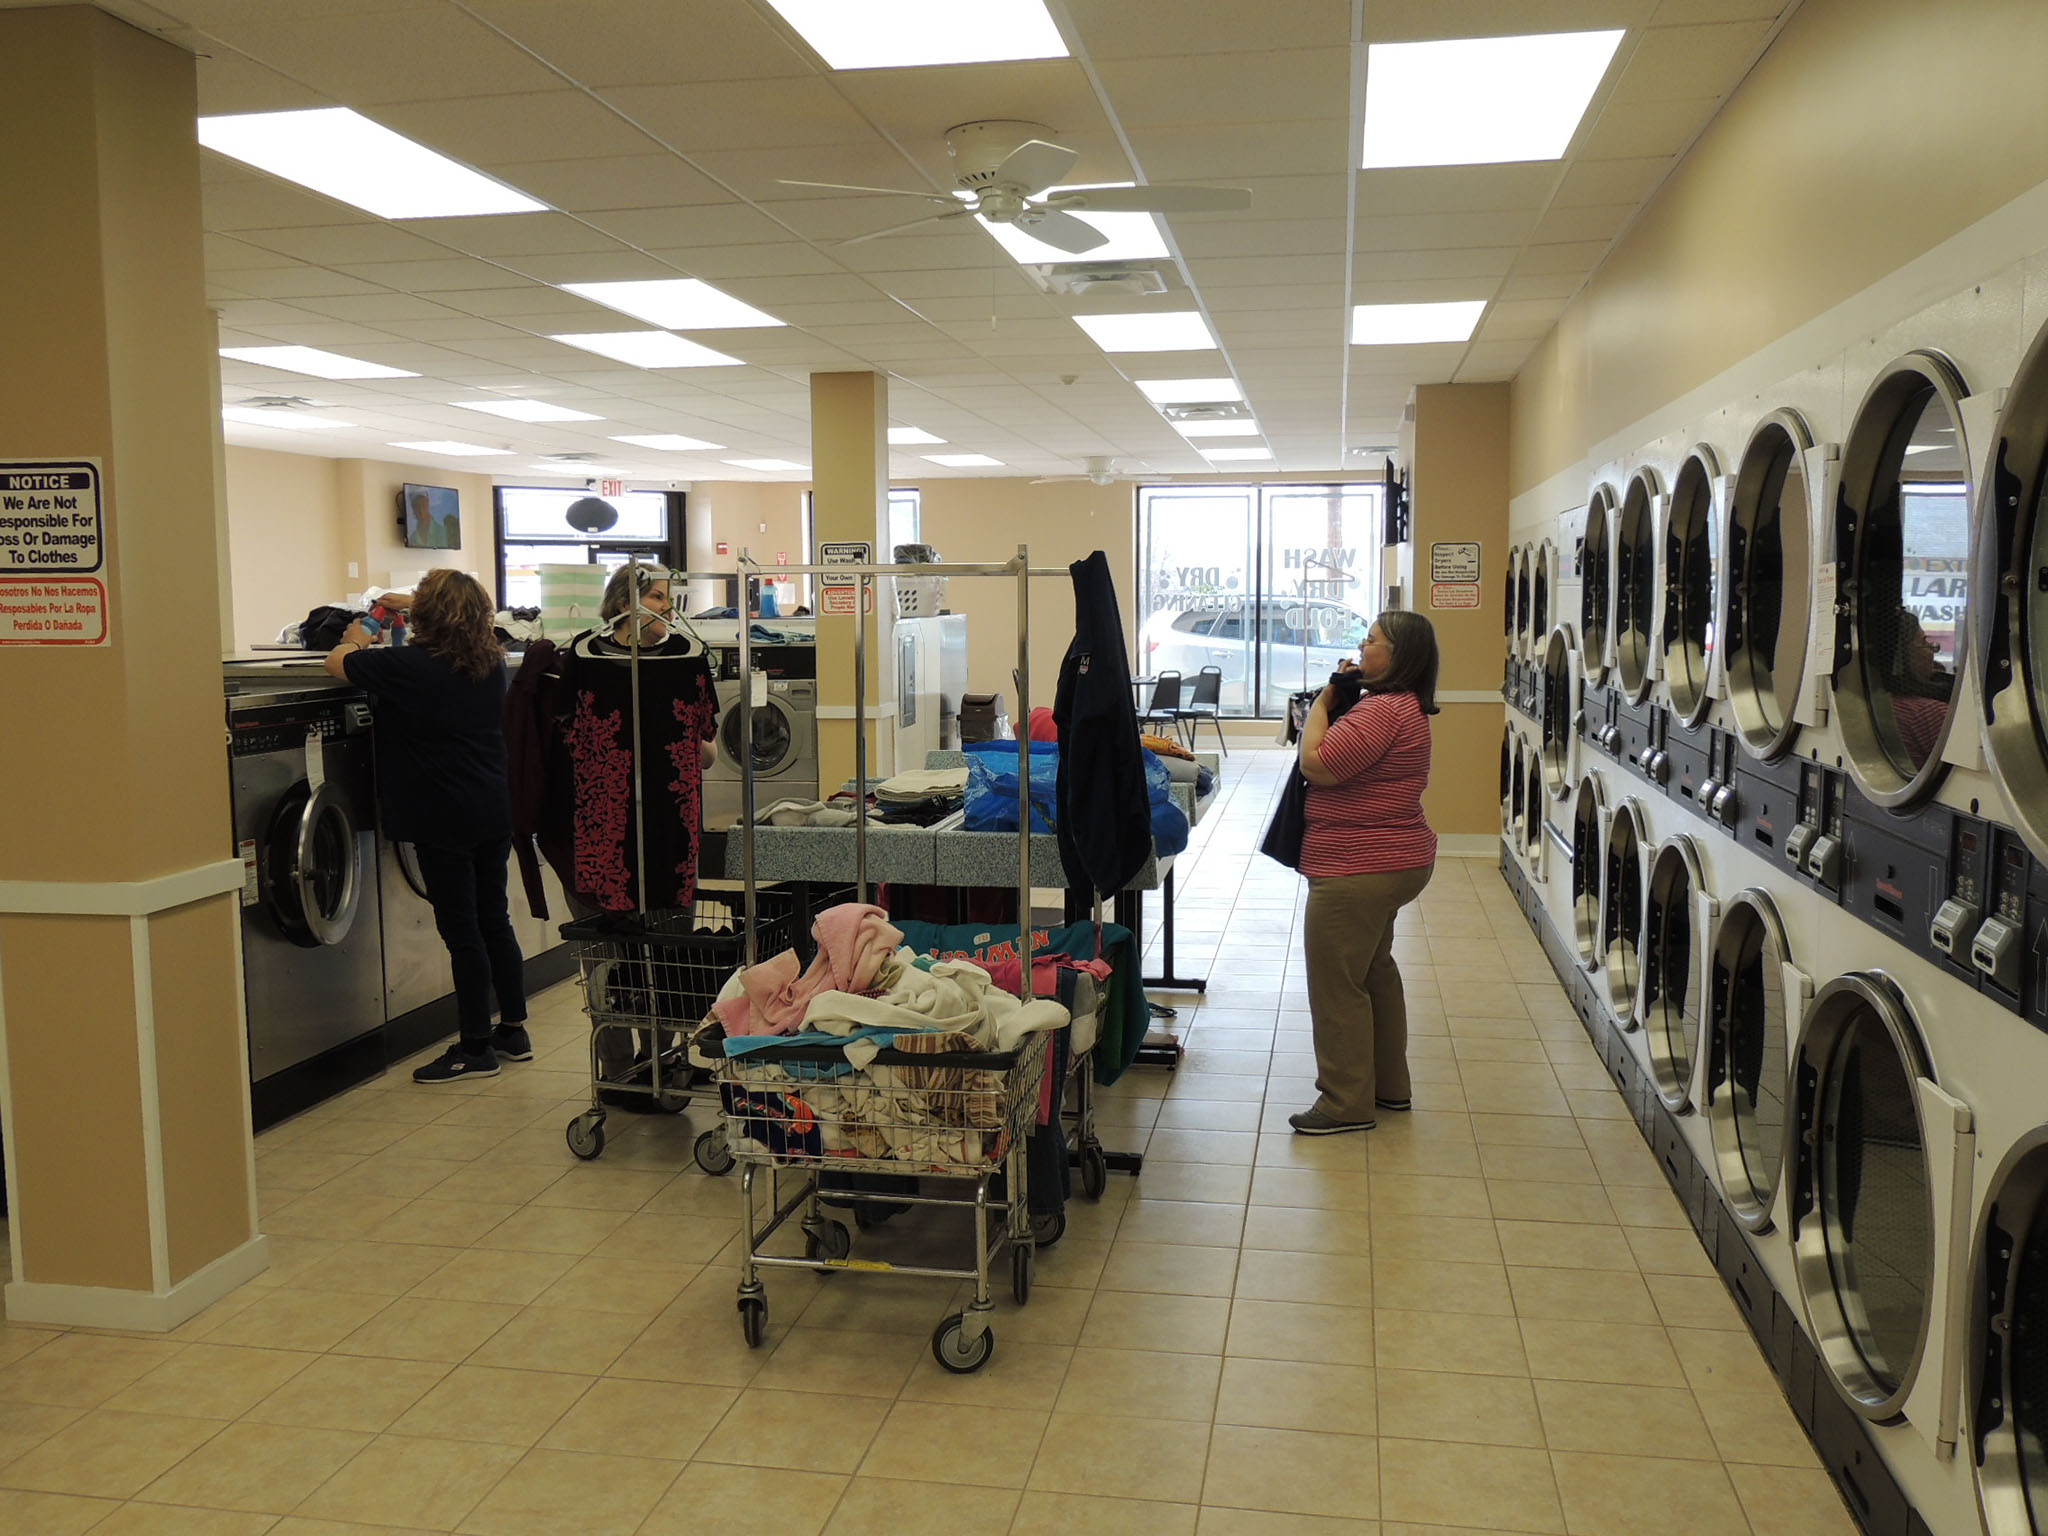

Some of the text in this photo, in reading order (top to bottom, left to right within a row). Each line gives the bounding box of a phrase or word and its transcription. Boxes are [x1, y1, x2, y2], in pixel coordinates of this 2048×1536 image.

[9, 475, 70, 489] NOTICE
[602, 480, 622, 497] EXIT
[3, 495, 77, 510] We Are Not
[0, 513, 93, 531] esponsible For
[0, 531, 96, 548] oss Or Damage
[8, 549, 78, 564] To Clothes
[0, 585, 98, 597] osotros No Nos Hacemos
[49, 602, 62, 614] Por
[64, 602, 74, 613] La
[76, 602, 96, 615] Ropa
[13, 619, 43, 631] Perdida
[45, 619, 51, 630] O
